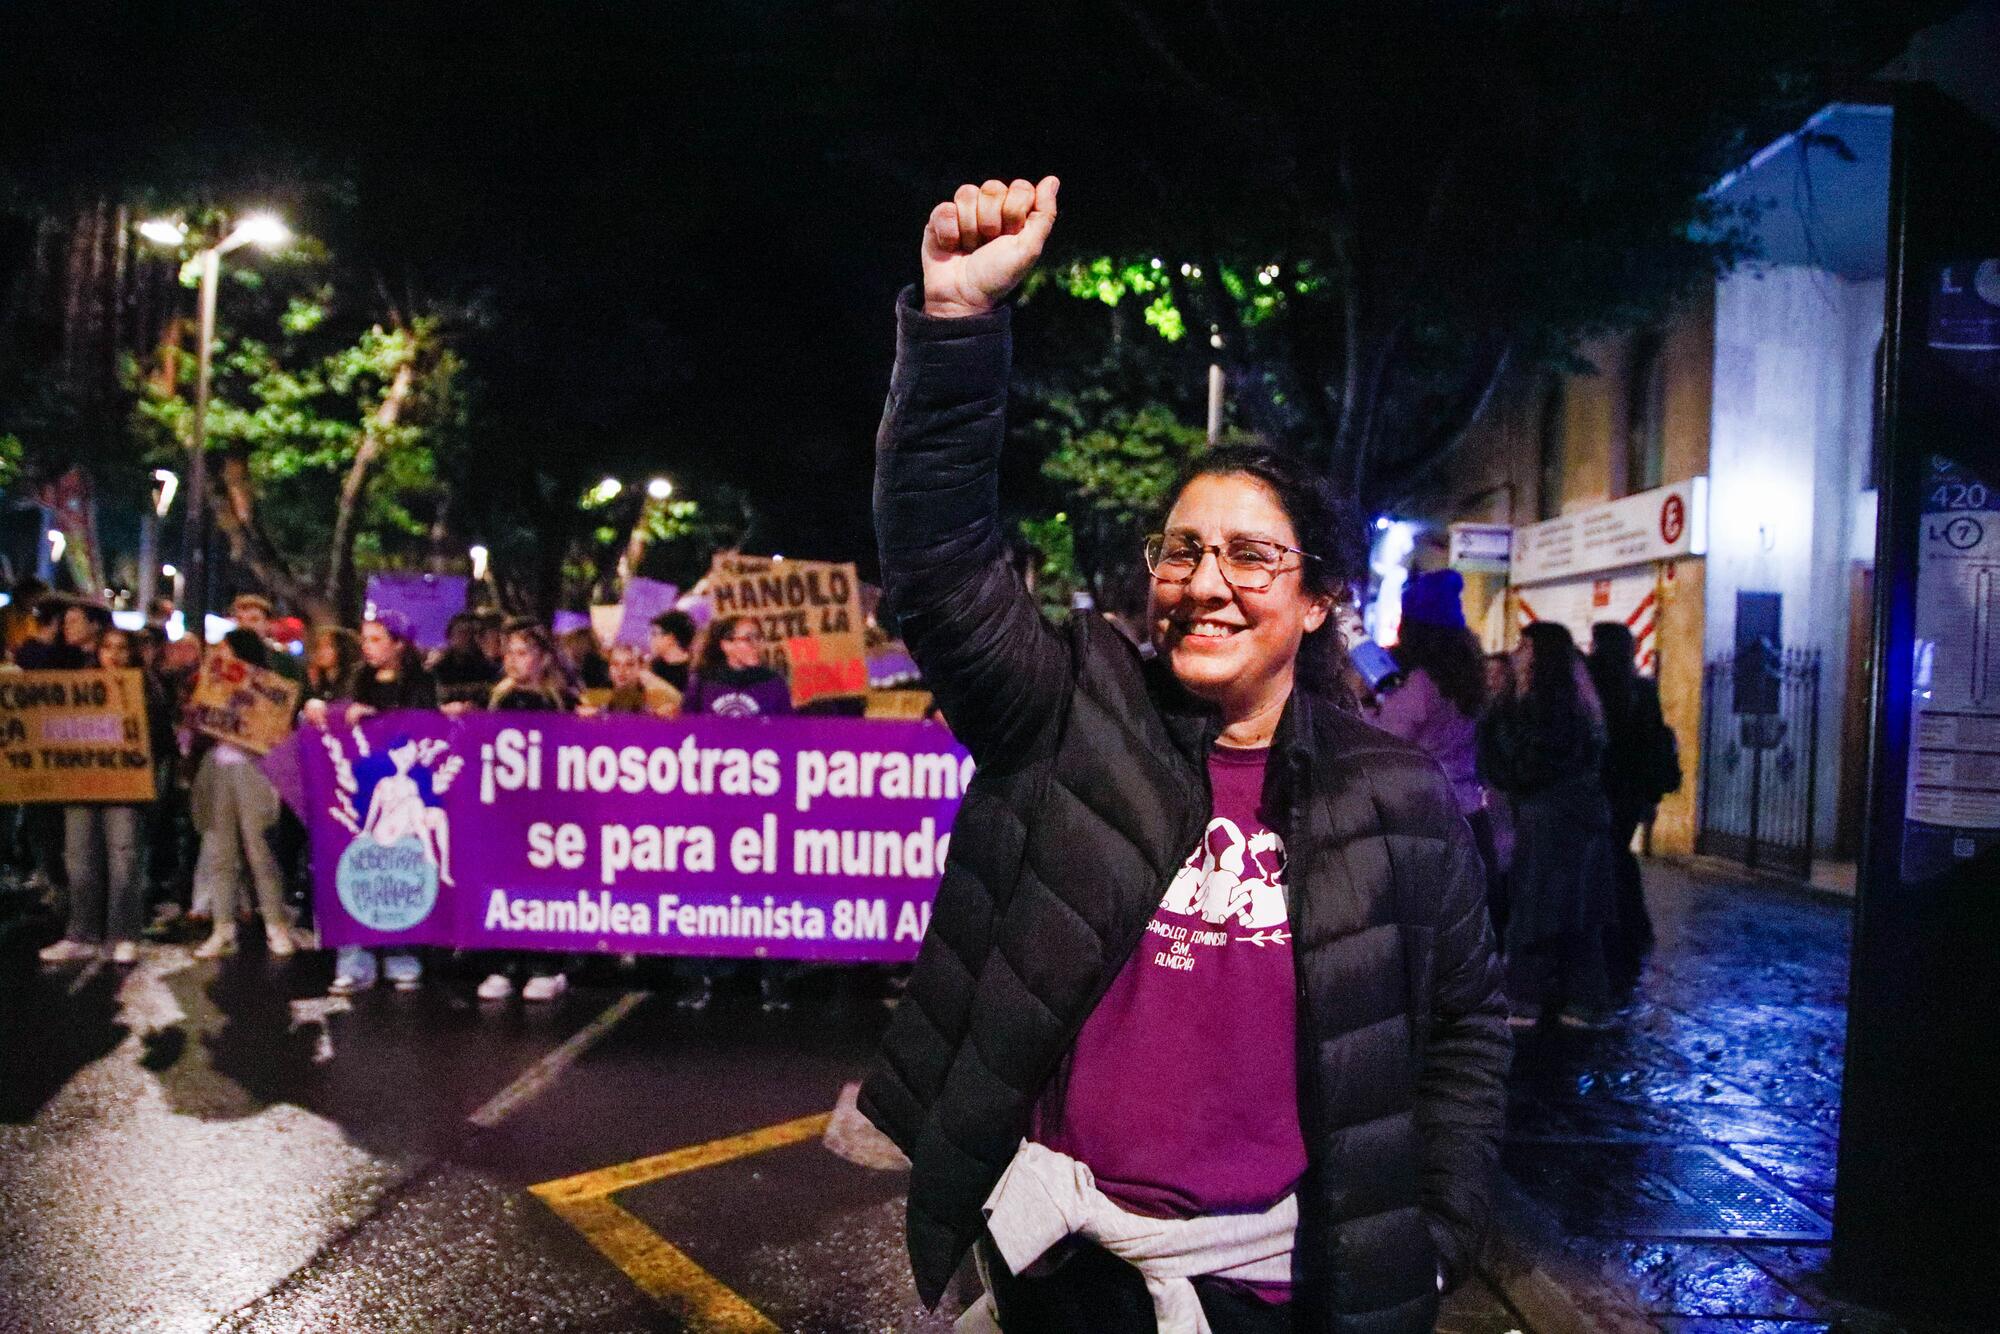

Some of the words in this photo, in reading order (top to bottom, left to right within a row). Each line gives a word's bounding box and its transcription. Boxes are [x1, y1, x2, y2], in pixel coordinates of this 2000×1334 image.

[1931, 483, 1987, 508] 420
[714, 569, 850, 612] MANOLO
[480, 728, 543, 804] ¡Si
[557, 733, 781, 797] nosotras
[527, 821, 588, 870] se
[601, 823, 717, 885] para
[730, 812, 778, 875] el
[484, 888, 650, 935] Asamblea
[658, 893, 826, 940] Feminista
[832, 898, 889, 941] 8M
[894, 900, 934, 943] Al
